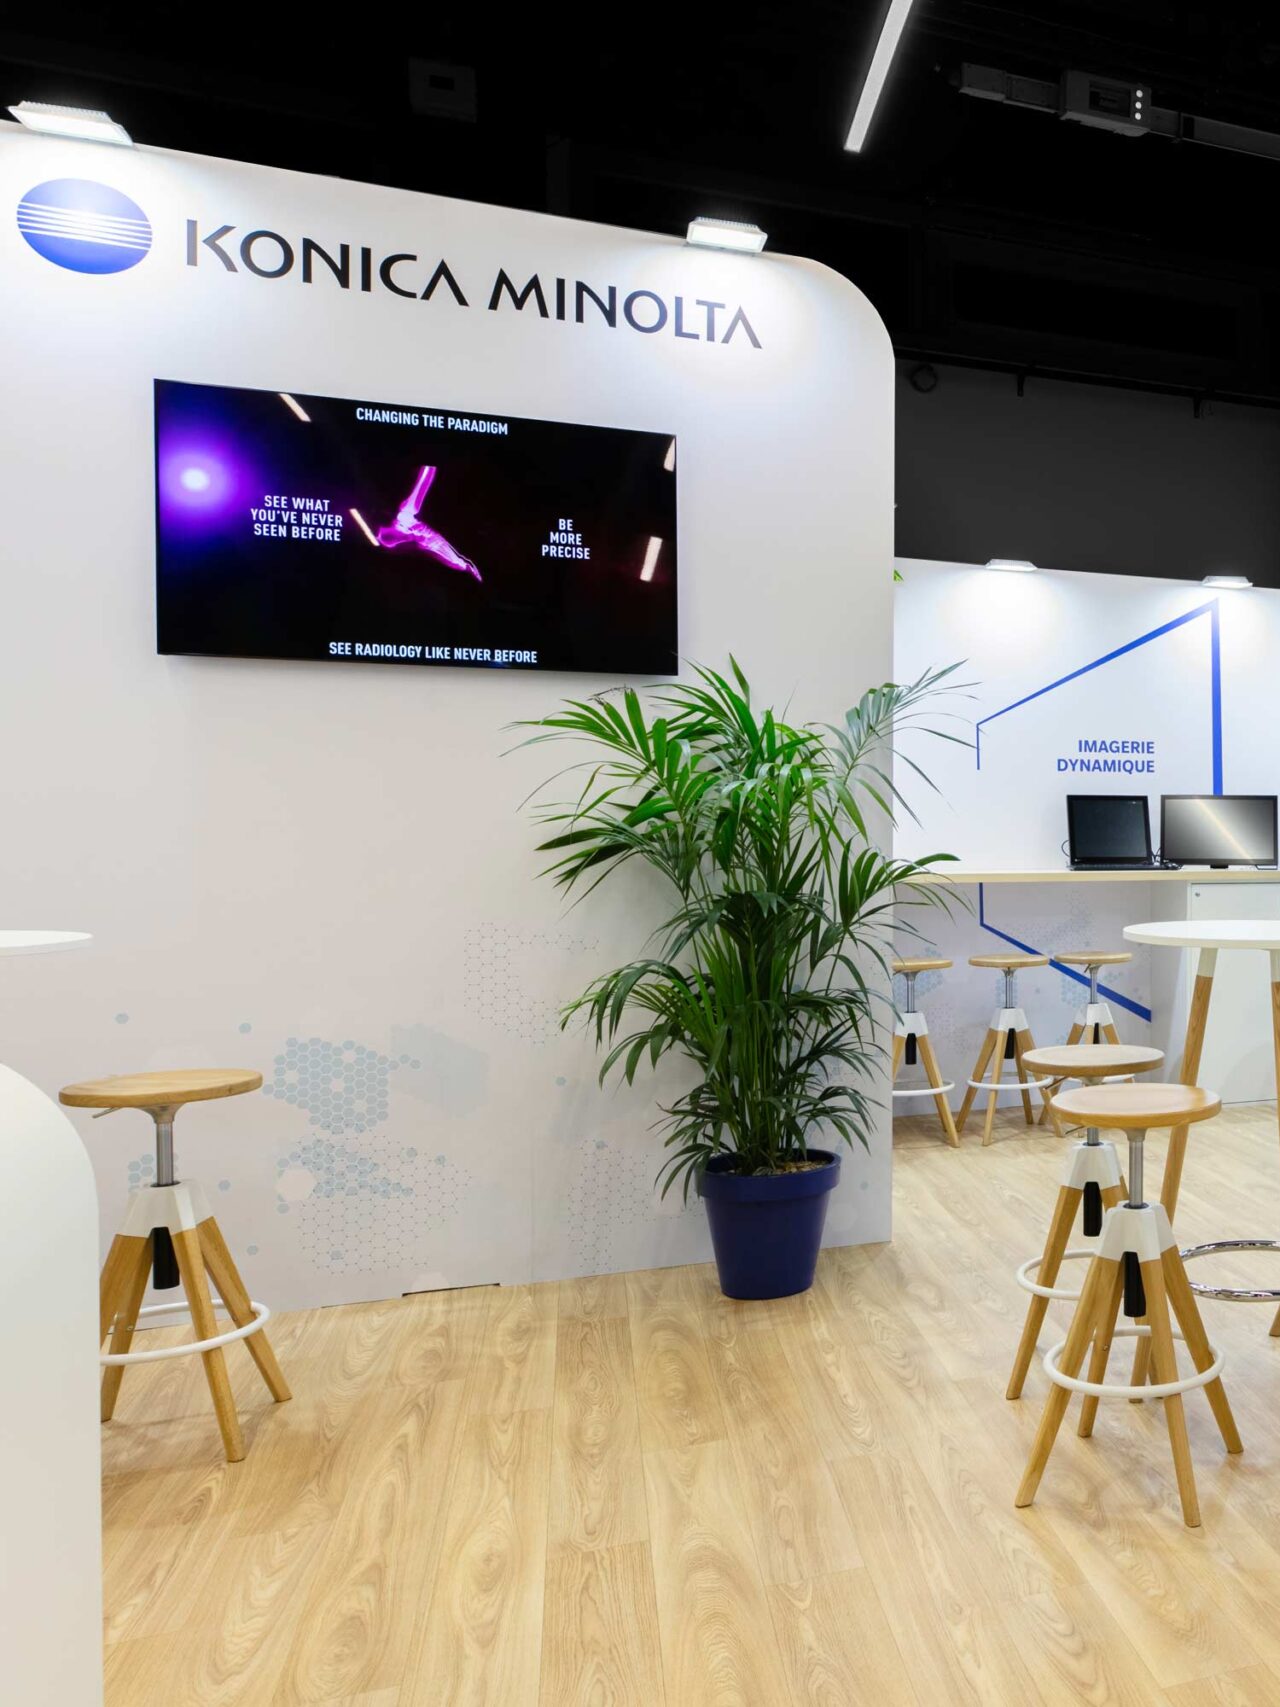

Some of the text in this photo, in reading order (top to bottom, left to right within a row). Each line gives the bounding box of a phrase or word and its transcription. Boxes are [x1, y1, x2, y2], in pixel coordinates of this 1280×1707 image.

[186, 218, 763, 349] KONICA MINOLTA
[356, 407, 508, 435] CHANGING THE PARADIGM
[264, 494, 330, 512] SEE WHAT
[250, 508, 343, 528] YOU'VE NEVER
[558, 518, 574, 531] BE
[253, 523, 341, 541] SEEN BEFORE
[549, 532, 582, 546] MORE
[541, 545, 591, 560] PRECISE
[329, 641, 538, 663] SEE RADIOLOGY LIKE NEVER BEFORE
[1078, 739, 1155, 754] IMAGERIE
[1057, 758, 1155, 775] DYNAMIQUE
